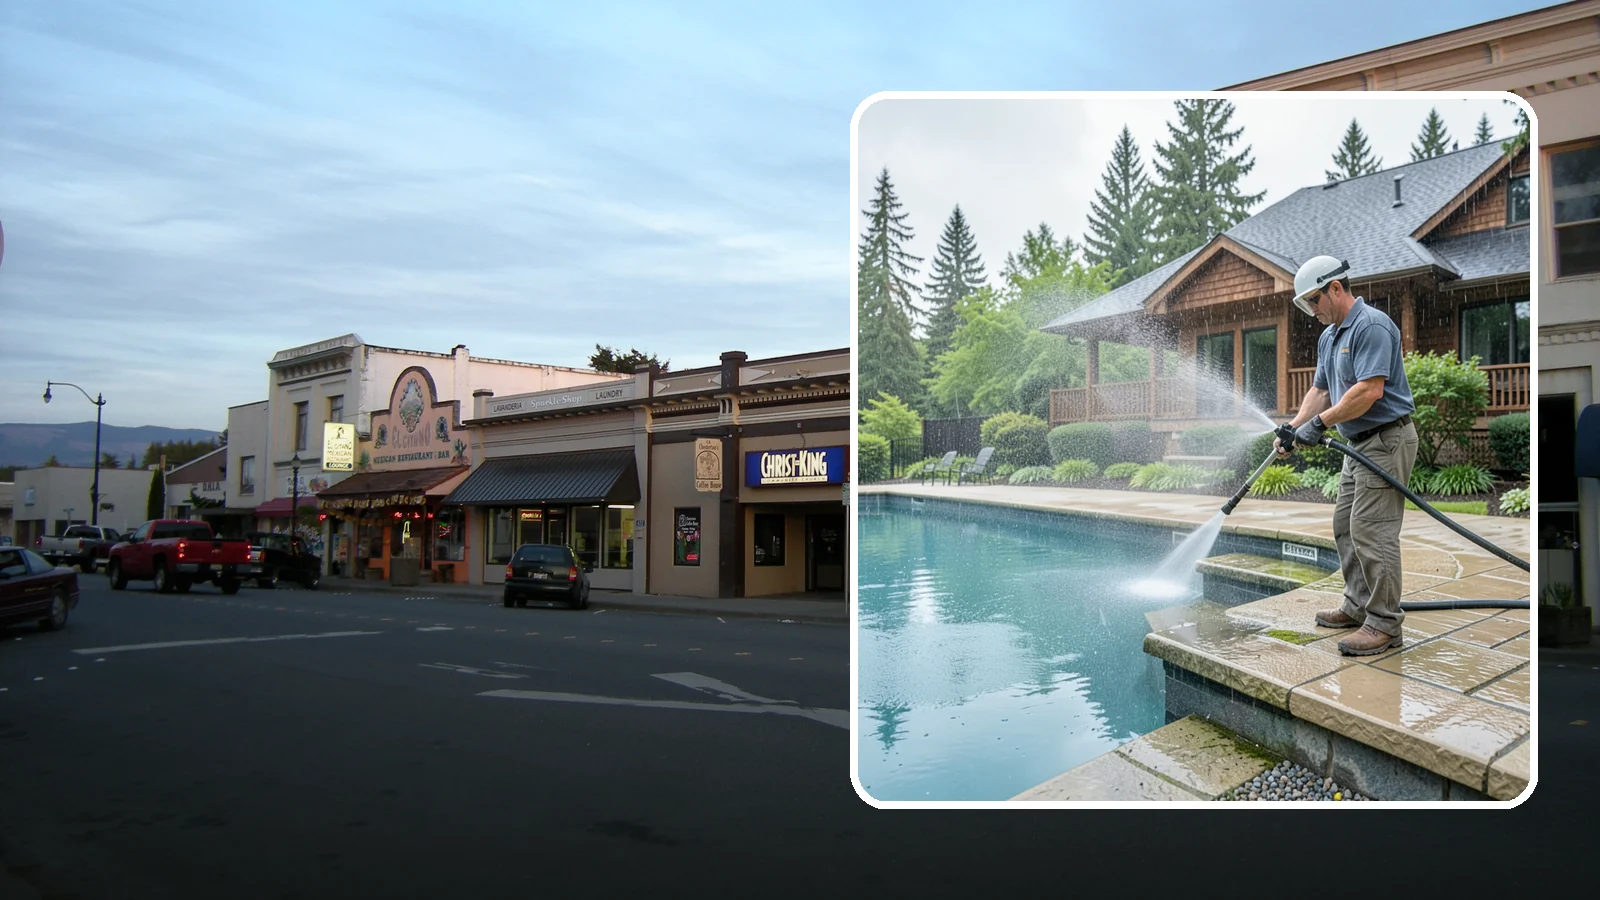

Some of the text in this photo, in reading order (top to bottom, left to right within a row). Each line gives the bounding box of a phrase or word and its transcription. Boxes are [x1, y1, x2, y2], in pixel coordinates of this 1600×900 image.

[530, 394, 582, 409] Sparkle Shop
[595, 389, 624, 400] LAUNDRY
[493, 402, 523, 413] LAVANDERIA
[373, 450, 450, 464] MEXICAN RESTAURANT BAR
[761, 449, 827, 478] CHRIST KING
